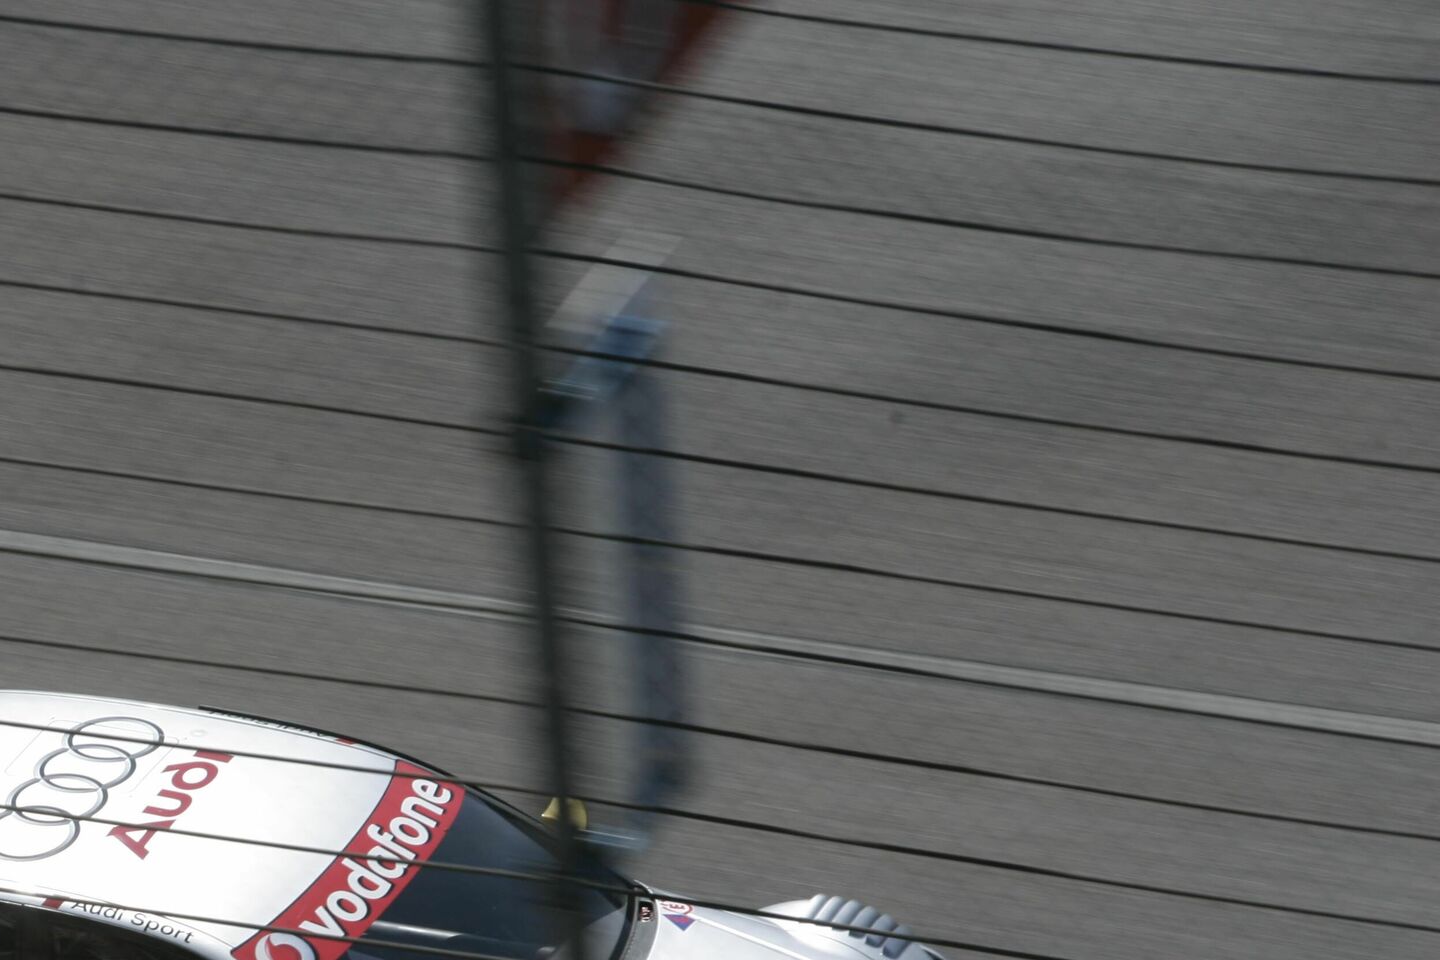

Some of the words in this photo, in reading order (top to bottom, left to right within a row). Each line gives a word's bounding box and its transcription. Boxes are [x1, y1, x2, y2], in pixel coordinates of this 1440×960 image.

[106, 749, 235, 860] Audi
[299, 777, 452, 938] vodafone
[71, 899, 124, 921] Audi
[130, 912, 194, 943] Sport
